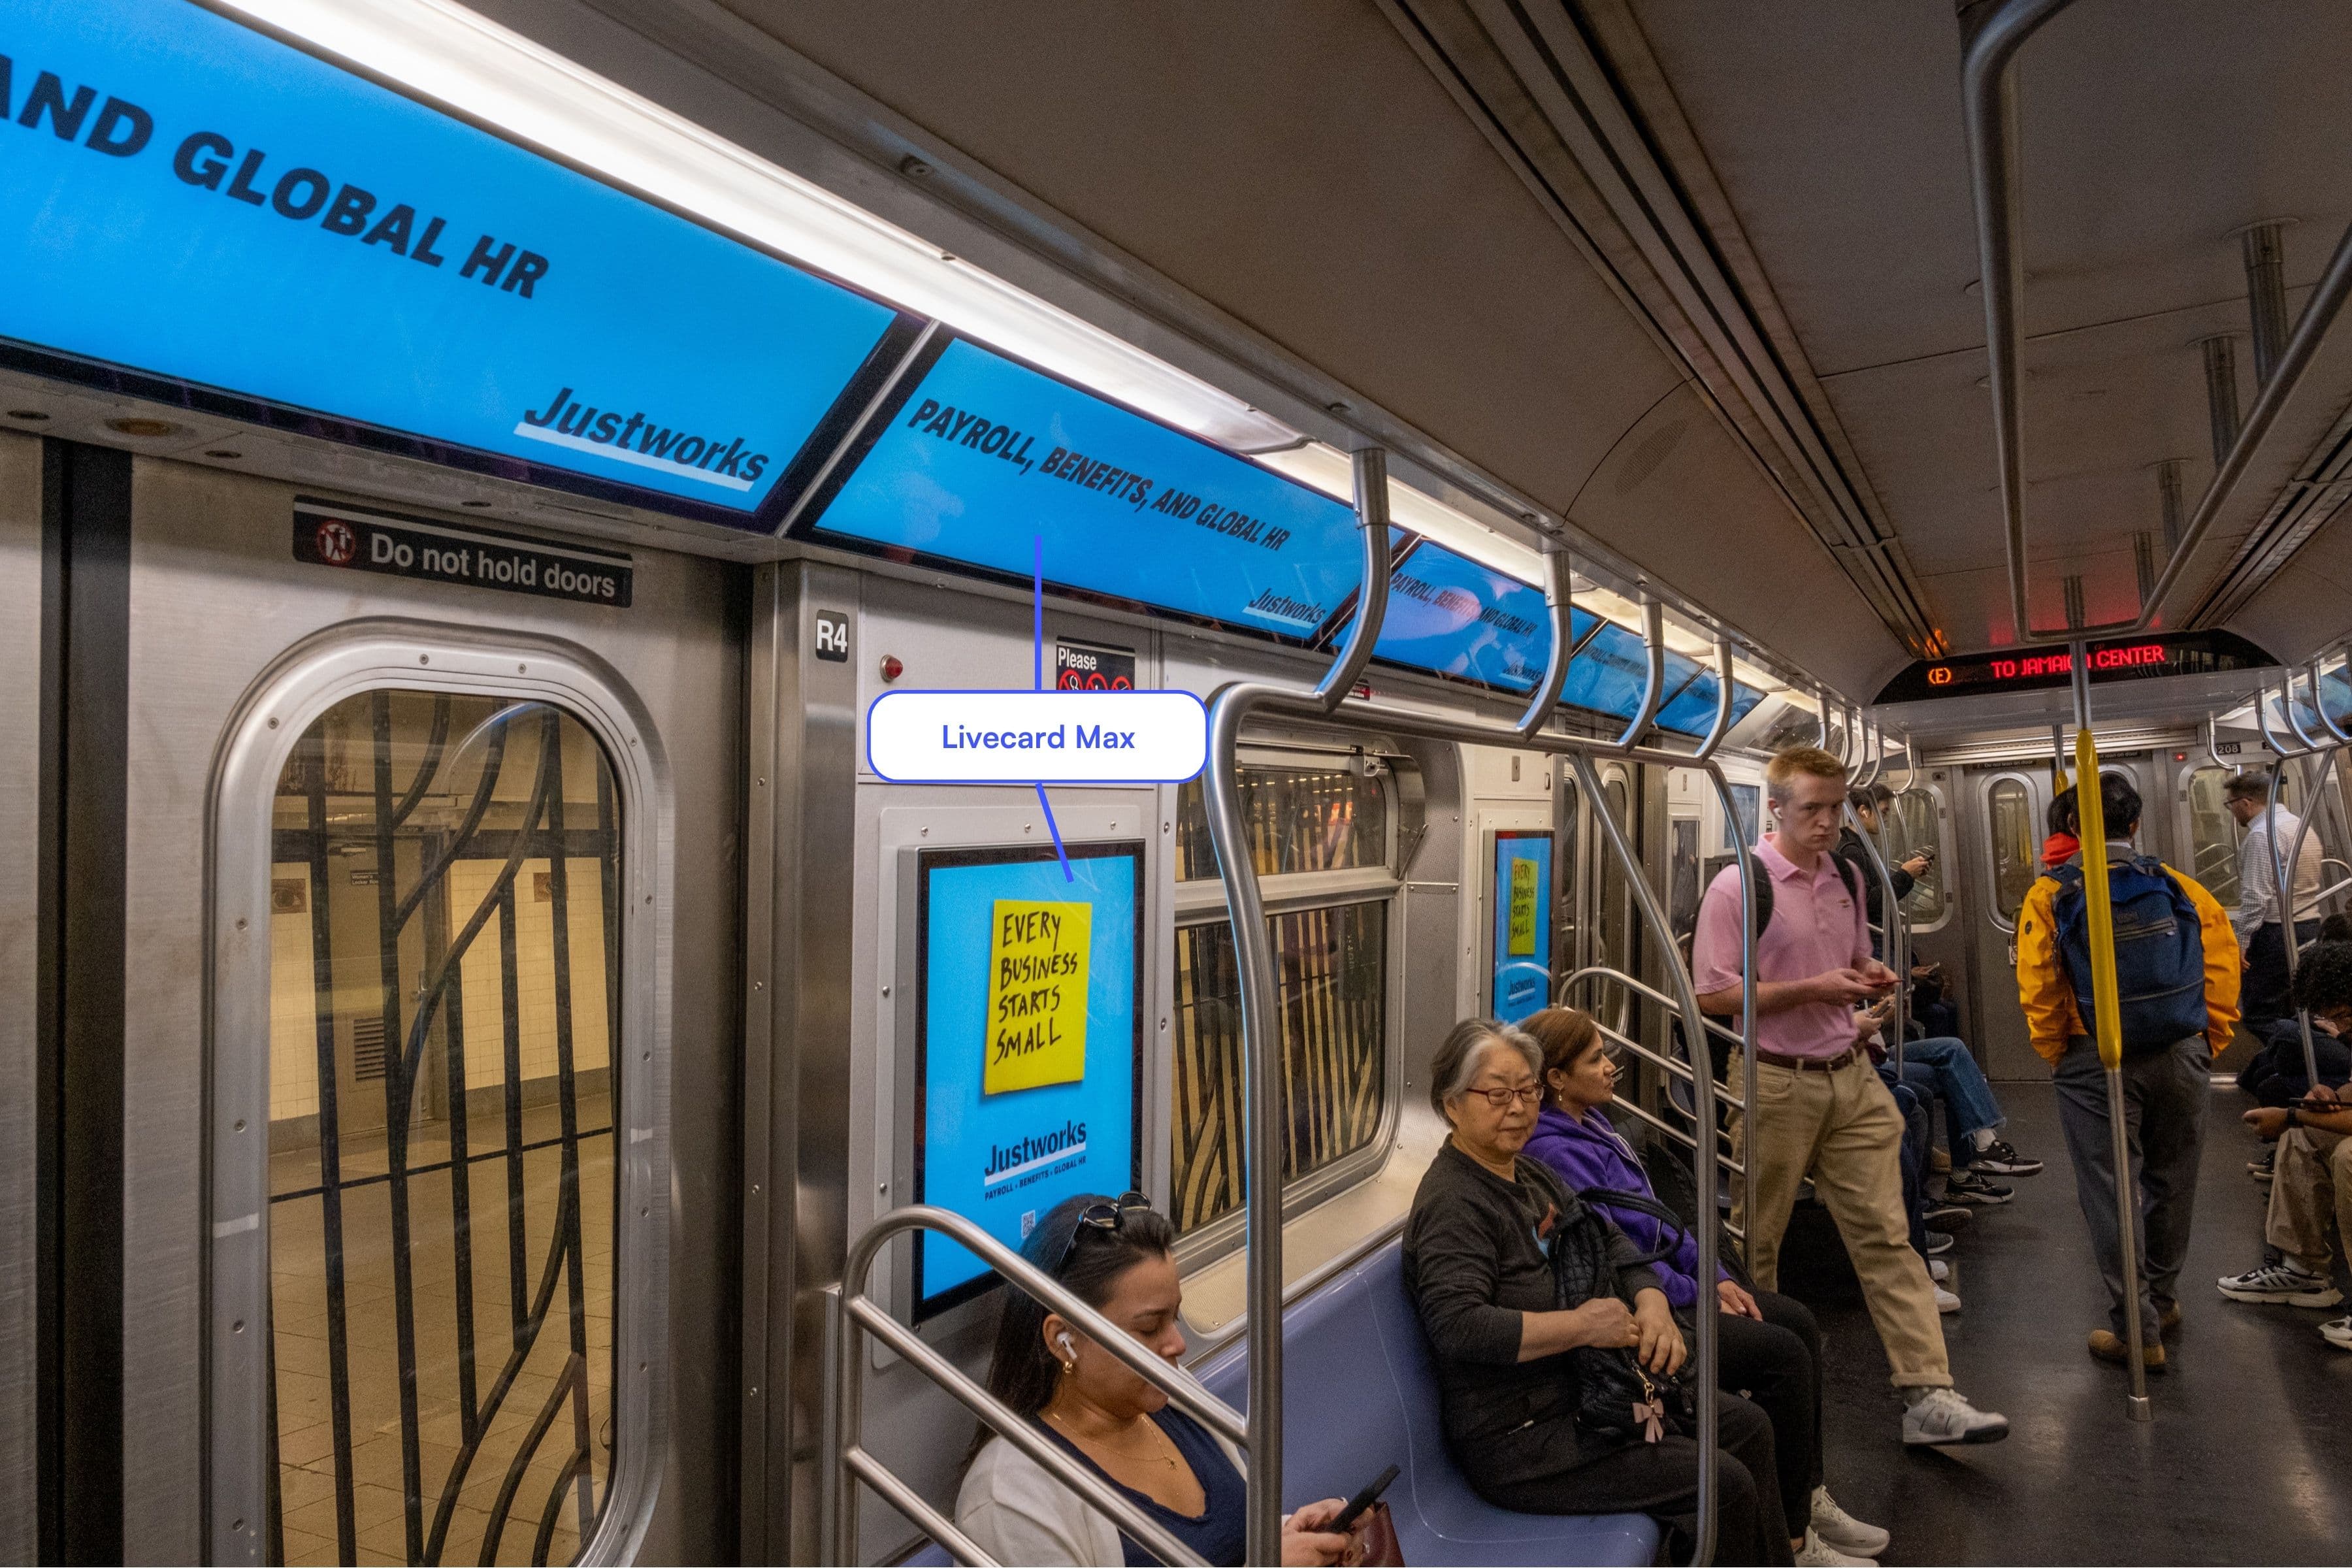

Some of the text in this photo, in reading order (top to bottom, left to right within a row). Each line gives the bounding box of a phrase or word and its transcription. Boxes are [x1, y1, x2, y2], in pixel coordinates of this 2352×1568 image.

[0, 53, 550, 299] ND GLOBAL HR
[523, 387, 770, 483] Justworks
[907, 398, 1292, 551] PAYROLL, BENEFITS, AND GLOBAL HR
[370, 532, 615, 597] Do not hold doors
[1249, 587, 1327, 624] Justworks
[817, 619, 848, 653] R4
[1058, 647, 1097, 671] Please
[1991, 660, 2016, 679] TO
[2096, 645, 2165, 668] CENTER
[1002, 911, 1061, 953] EVERY
[1000, 952, 1078, 992] BUSINESS
[998, 984, 1060, 1023] STARTS
[993, 1016, 1062, 1066] SMALL
[984, 1119, 1087, 1177] Justworks
[985, 1155, 1086, 1201] PAYROLL BENEFITS GLOBAL HR
